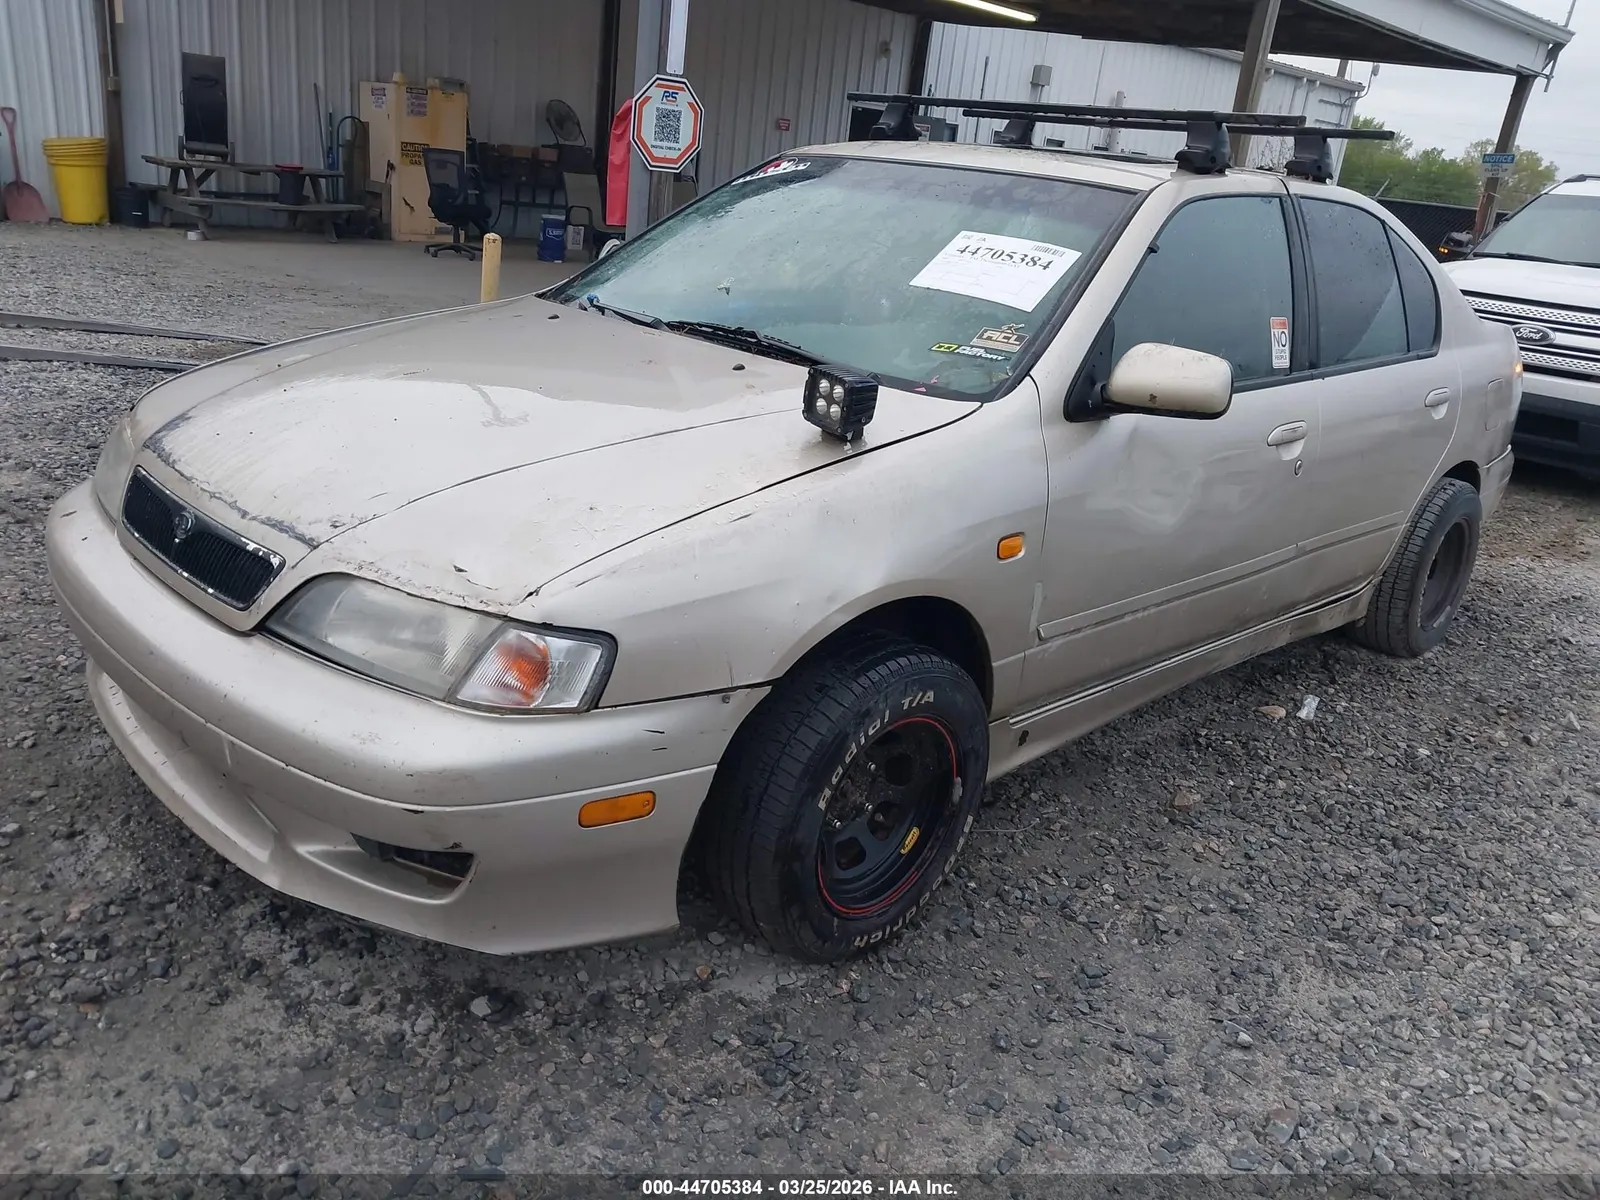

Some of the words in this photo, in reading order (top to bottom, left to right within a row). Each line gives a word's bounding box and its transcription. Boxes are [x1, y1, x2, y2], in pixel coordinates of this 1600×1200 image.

[401, 152, 424, 160] PROPA
[956, 244, 1054, 271] 44705384
[982, 330, 1021, 344] ACL
[1273, 331, 1287, 348] NO
[1516, 327, 1543, 340] Ford
[818, 709, 890, 811] Radial
[901, 690, 934, 710] T/A
